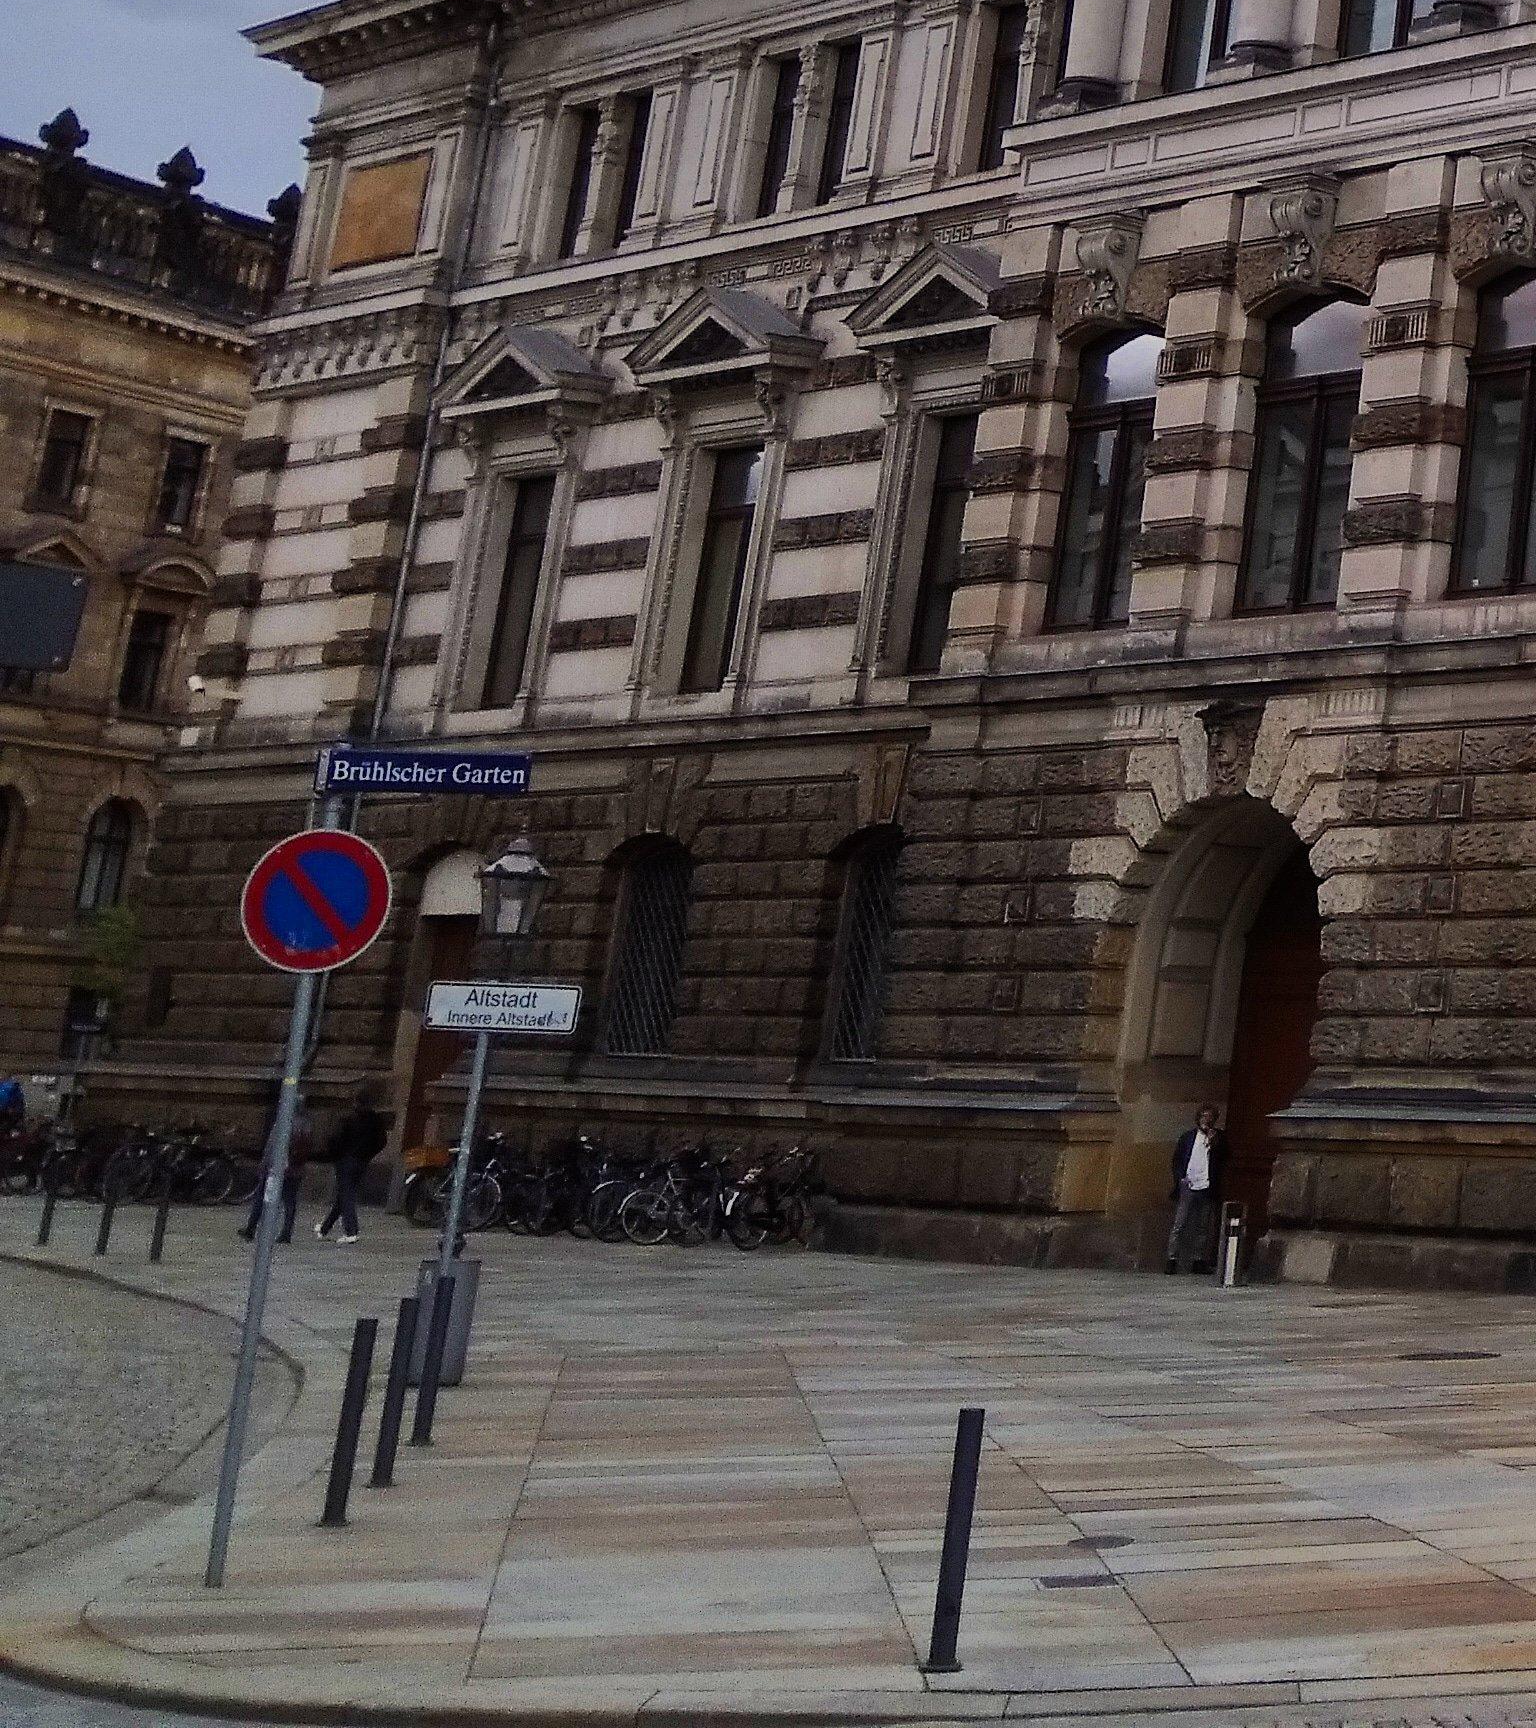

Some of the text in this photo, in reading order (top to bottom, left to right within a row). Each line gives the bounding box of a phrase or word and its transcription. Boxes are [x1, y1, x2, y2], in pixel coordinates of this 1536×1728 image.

[332, 760, 525, 784] Brühlscher Garten
[464, 988, 538, 1008] Altstadt
[447, 1010, 492, 1025] Innere
